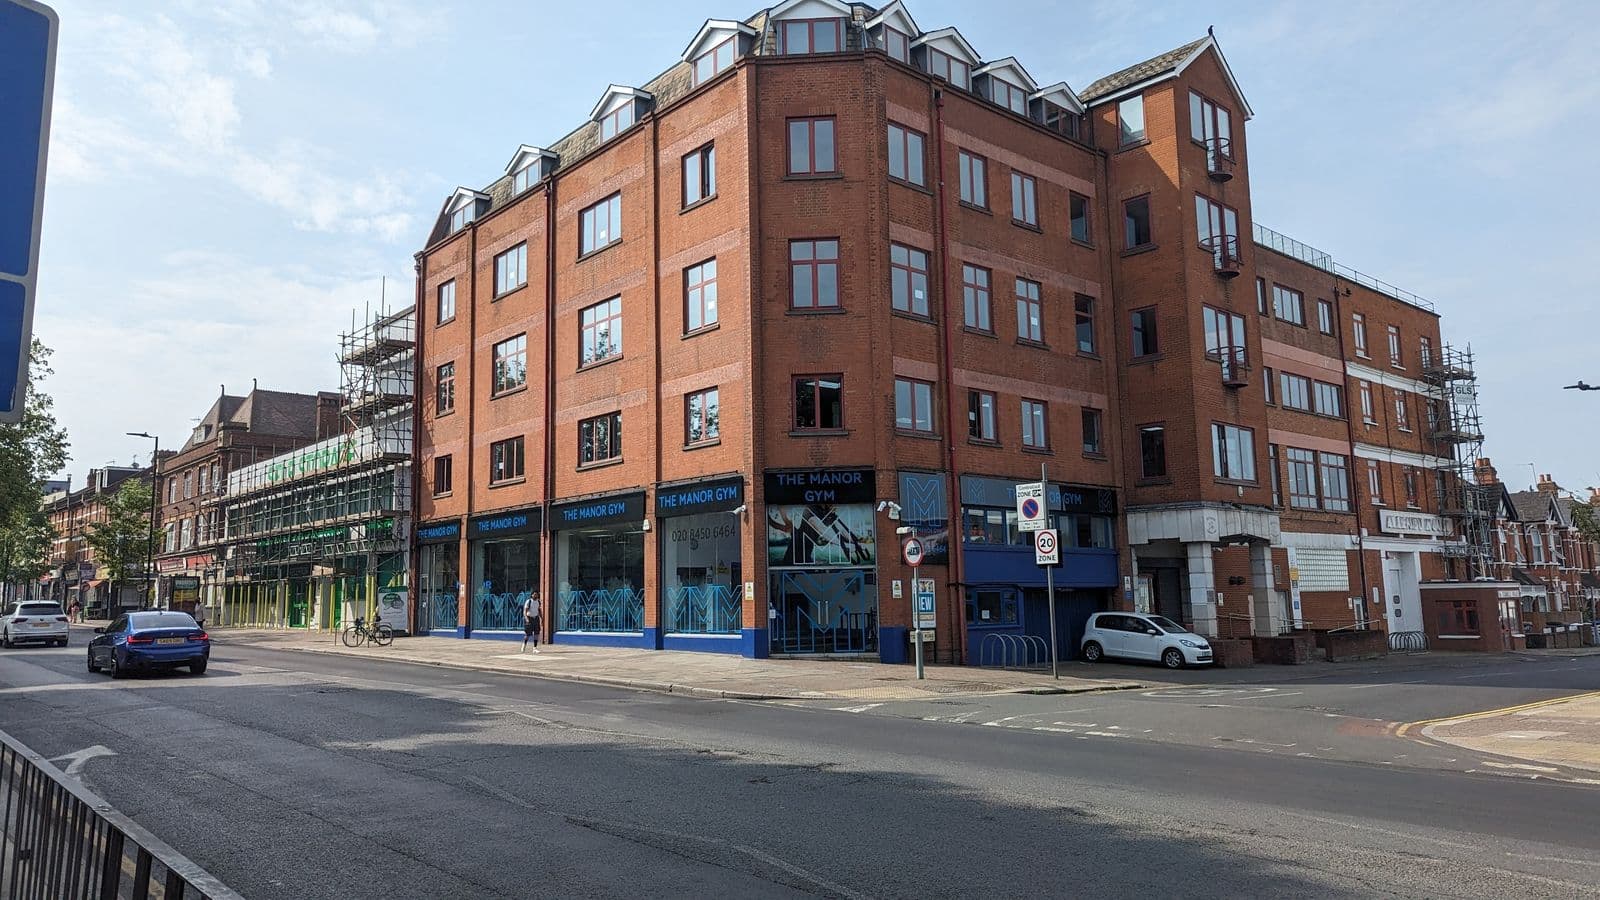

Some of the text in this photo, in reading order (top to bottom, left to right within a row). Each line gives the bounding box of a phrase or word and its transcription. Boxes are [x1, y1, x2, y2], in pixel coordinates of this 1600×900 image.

[1455, 386, 1473, 395] GLS
[777, 472, 862, 485] THE MANOR
[658, 486, 737, 508] THE MANOR GYM
[804, 490, 835, 502] GYM
[1063, 493, 1082, 505] GYM
[563, 502, 625, 520] THE MANOR GYM
[478, 516, 527, 531] THE MANOR GYM
[417, 525, 458, 539] THE MANOR GYM
[672, 525, 736, 542] 020 8450 6464
[1040, 538, 1053, 547] 20
